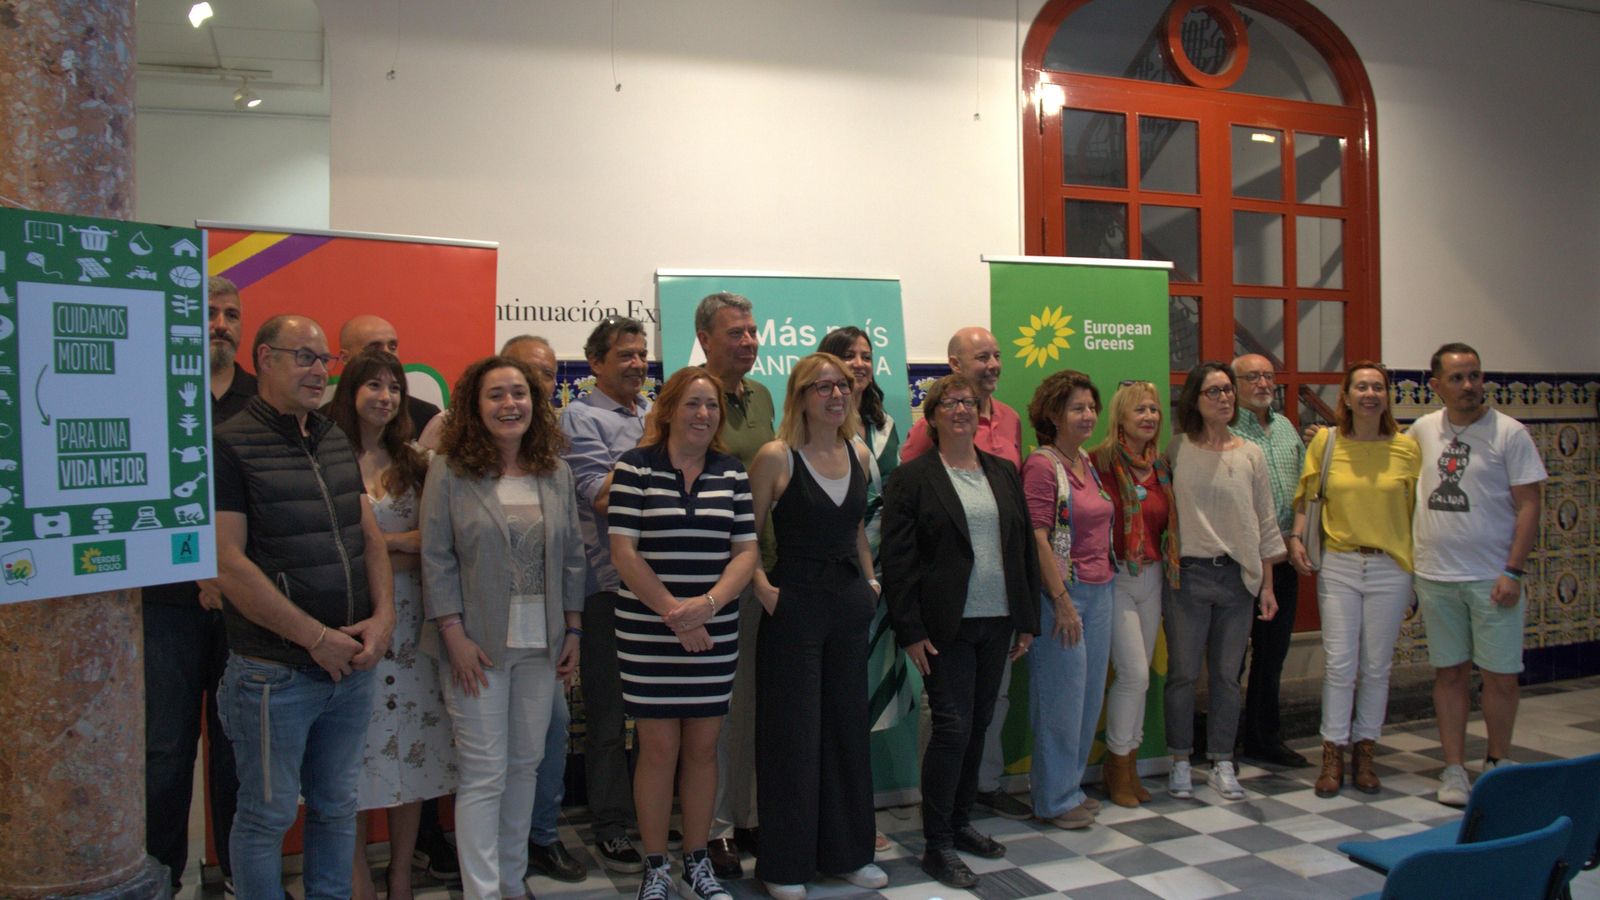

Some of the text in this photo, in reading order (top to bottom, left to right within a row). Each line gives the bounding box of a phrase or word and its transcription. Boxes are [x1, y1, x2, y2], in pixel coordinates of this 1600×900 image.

[57, 305, 126, 336] CUIDAMOS
[757, 317, 816, 346] Más
[1084, 319, 1152, 338] European
[1084, 335, 1135, 350] Greens
[58, 342, 113, 371] MOTRIL
[59, 421, 128, 449] PARA UNA
[60, 457, 145, 487] VIDA MEJOR
[1431, 492, 1466, 506] SALIDA
[90, 554, 121, 564] VERDES
[98, 562, 122, 571] EQUO
